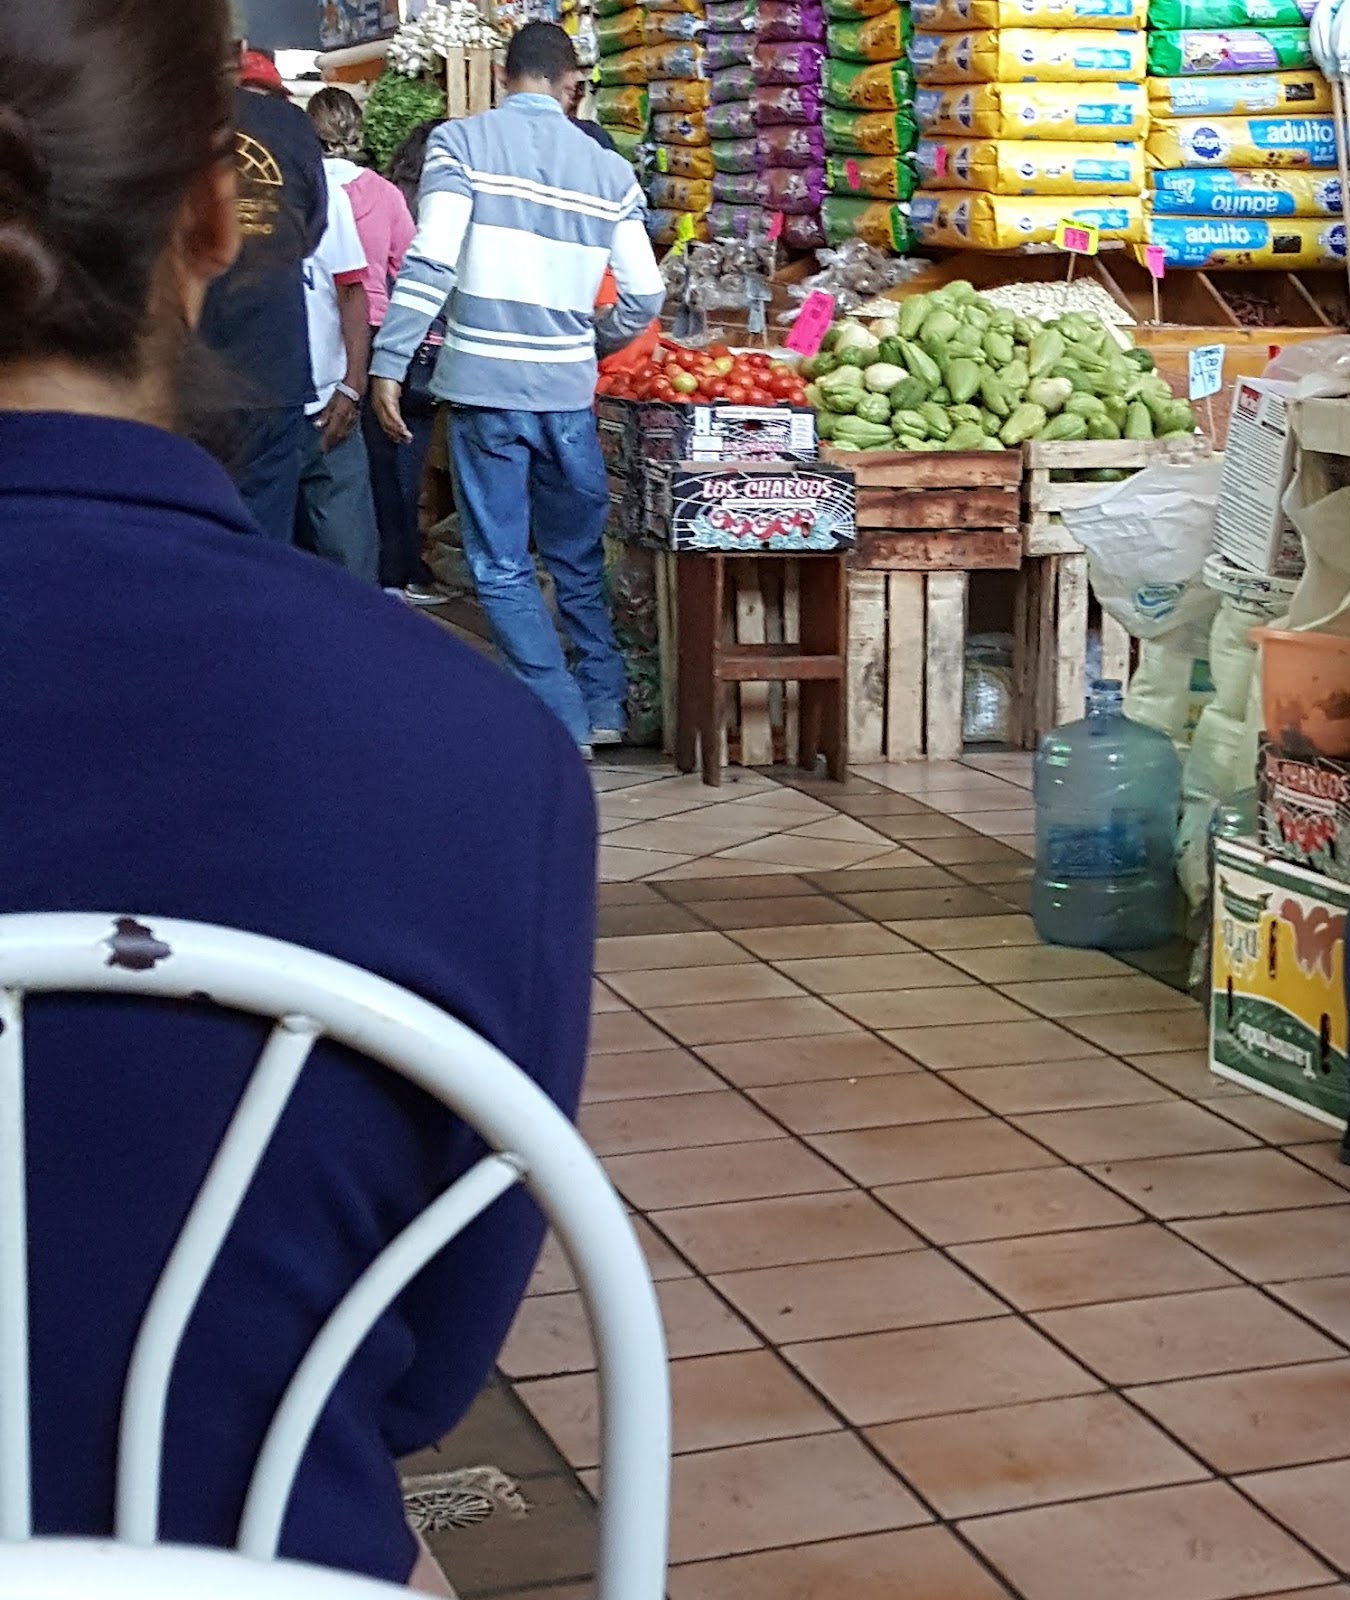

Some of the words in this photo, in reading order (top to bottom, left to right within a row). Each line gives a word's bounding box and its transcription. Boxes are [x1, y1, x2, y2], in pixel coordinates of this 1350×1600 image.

[1266, 120, 1334, 144] adulto
[1210, 194, 1279, 213] adulto
[1185, 223, 1250, 244] adulto
[702, 480, 738, 499] LOS
[744, 479, 835, 500] CHARCOS
